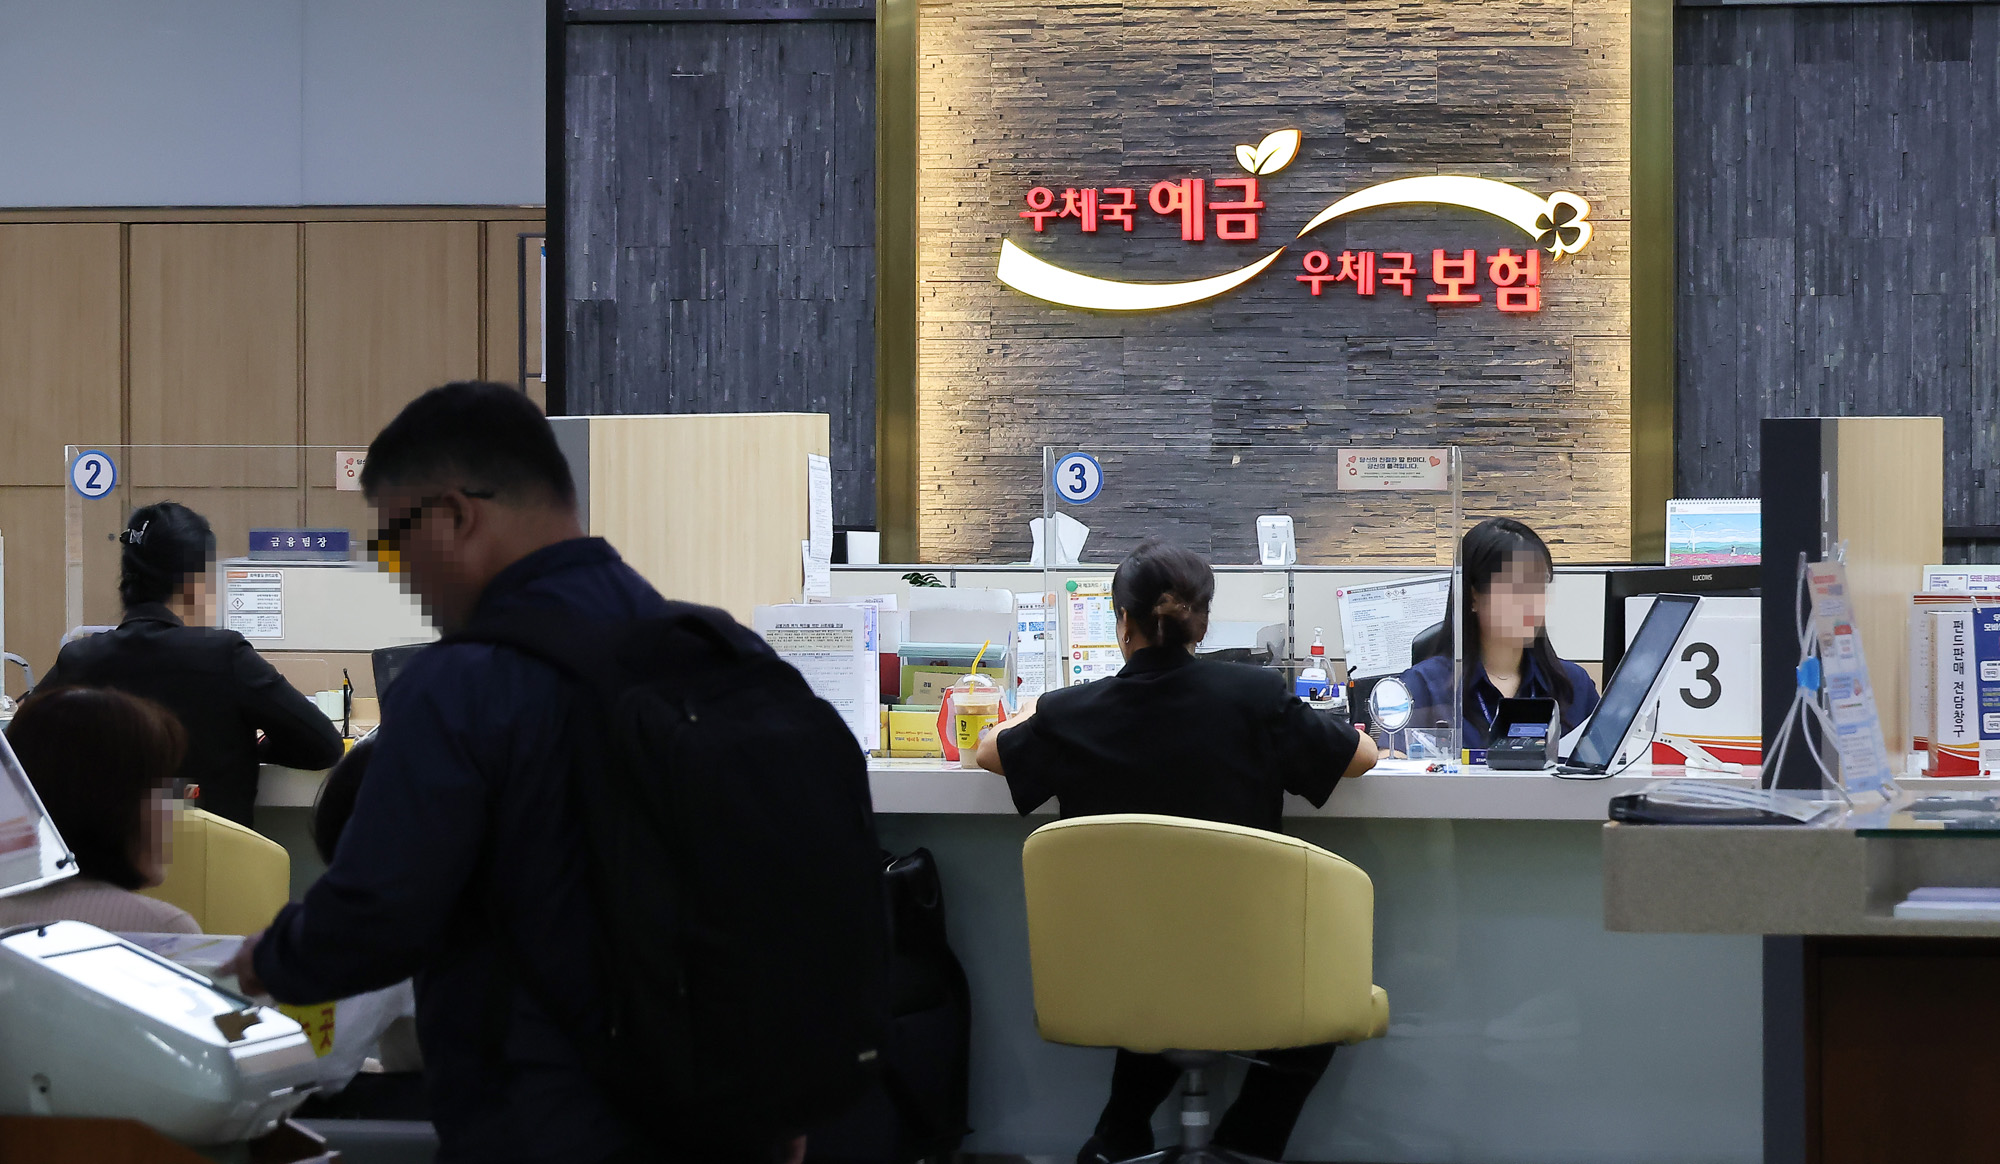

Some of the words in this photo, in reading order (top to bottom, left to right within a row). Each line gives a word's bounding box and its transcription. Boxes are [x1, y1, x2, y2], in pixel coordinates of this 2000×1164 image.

[1019, 186, 1137, 232] 우체국
[1148, 177, 1265, 241] 예금
[1296, 249, 1417, 296] 우체국
[1427, 248, 1541, 312] 보험
[85, 459, 102, 489] 2
[1069, 463, 1087, 493] 3
[1679, 642, 1722, 709] 3
[1952, 620, 1965, 675] 펀드판매
[1953, 681, 1965, 737] 전담창구
